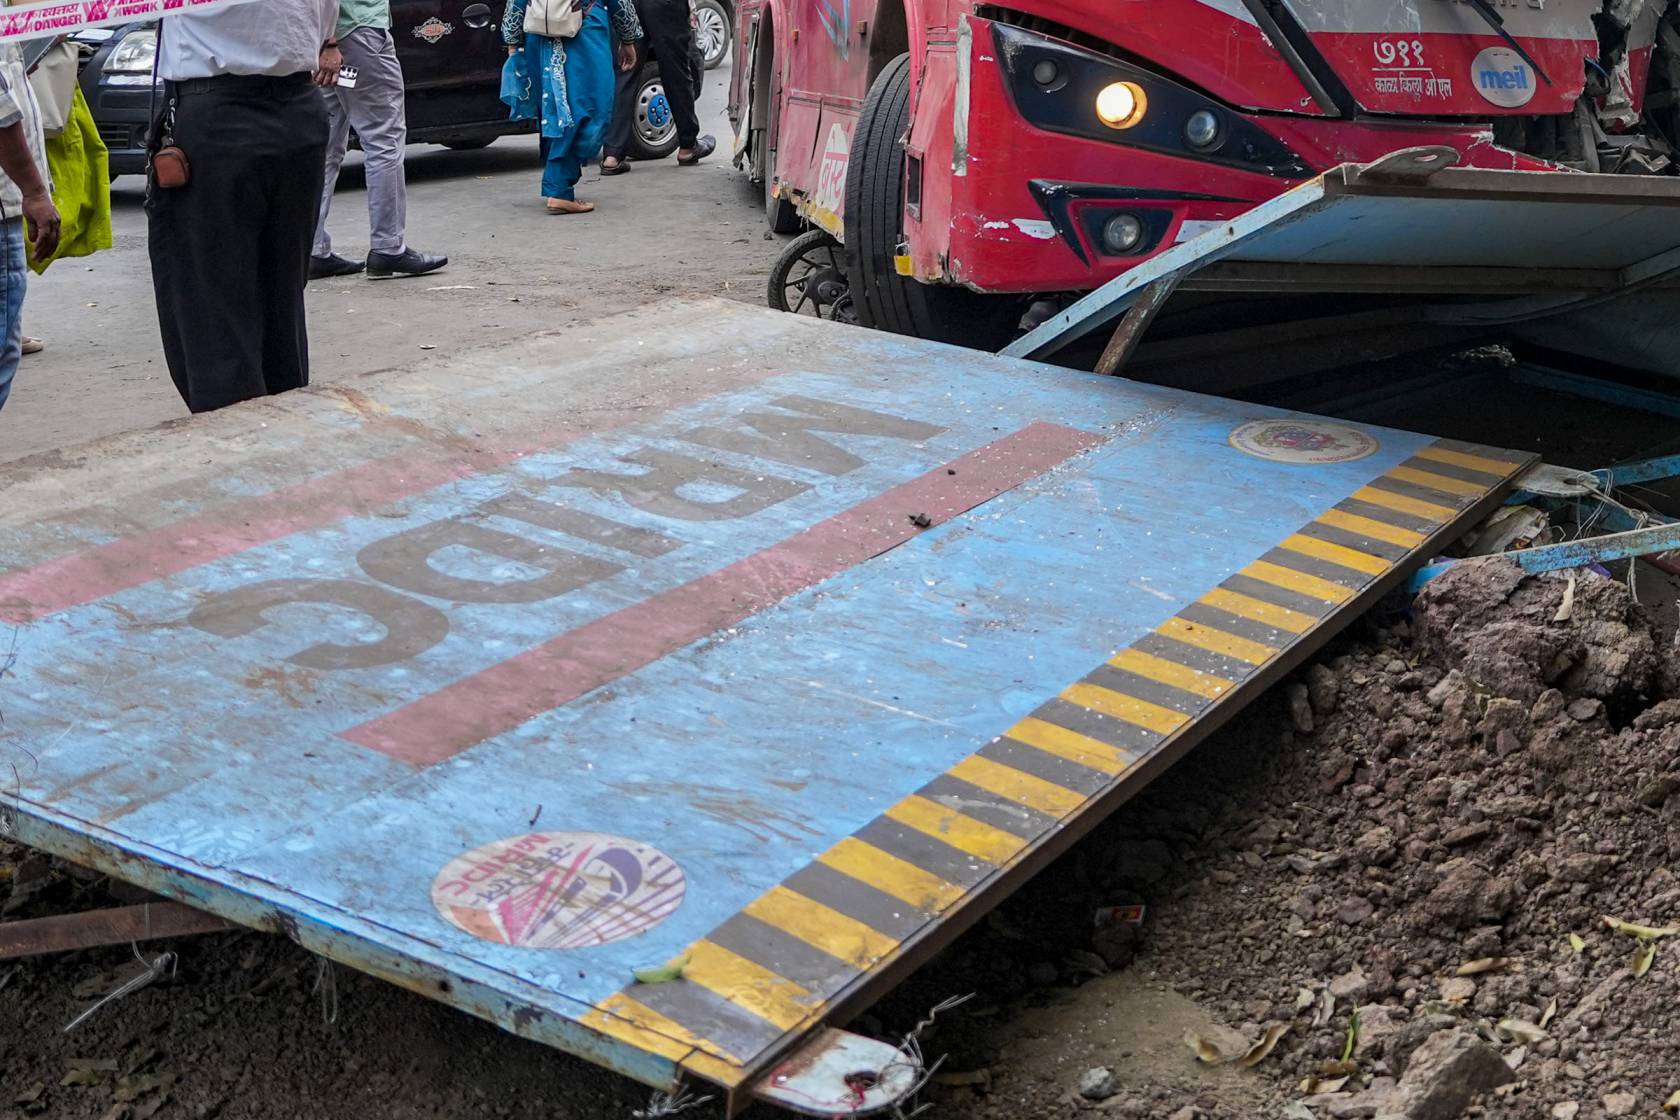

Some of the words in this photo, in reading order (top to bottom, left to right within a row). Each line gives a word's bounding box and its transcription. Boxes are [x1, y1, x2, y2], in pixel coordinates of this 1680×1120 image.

[122, 1, 159, 17] WORK
[34, 14, 82, 32] DANGER
[1373, 40, 1424, 67] ७११
[1480, 65, 1527, 89] meil
[185, 395, 948, 672] MRIDC
[438, 833, 552, 897] MRIDC
